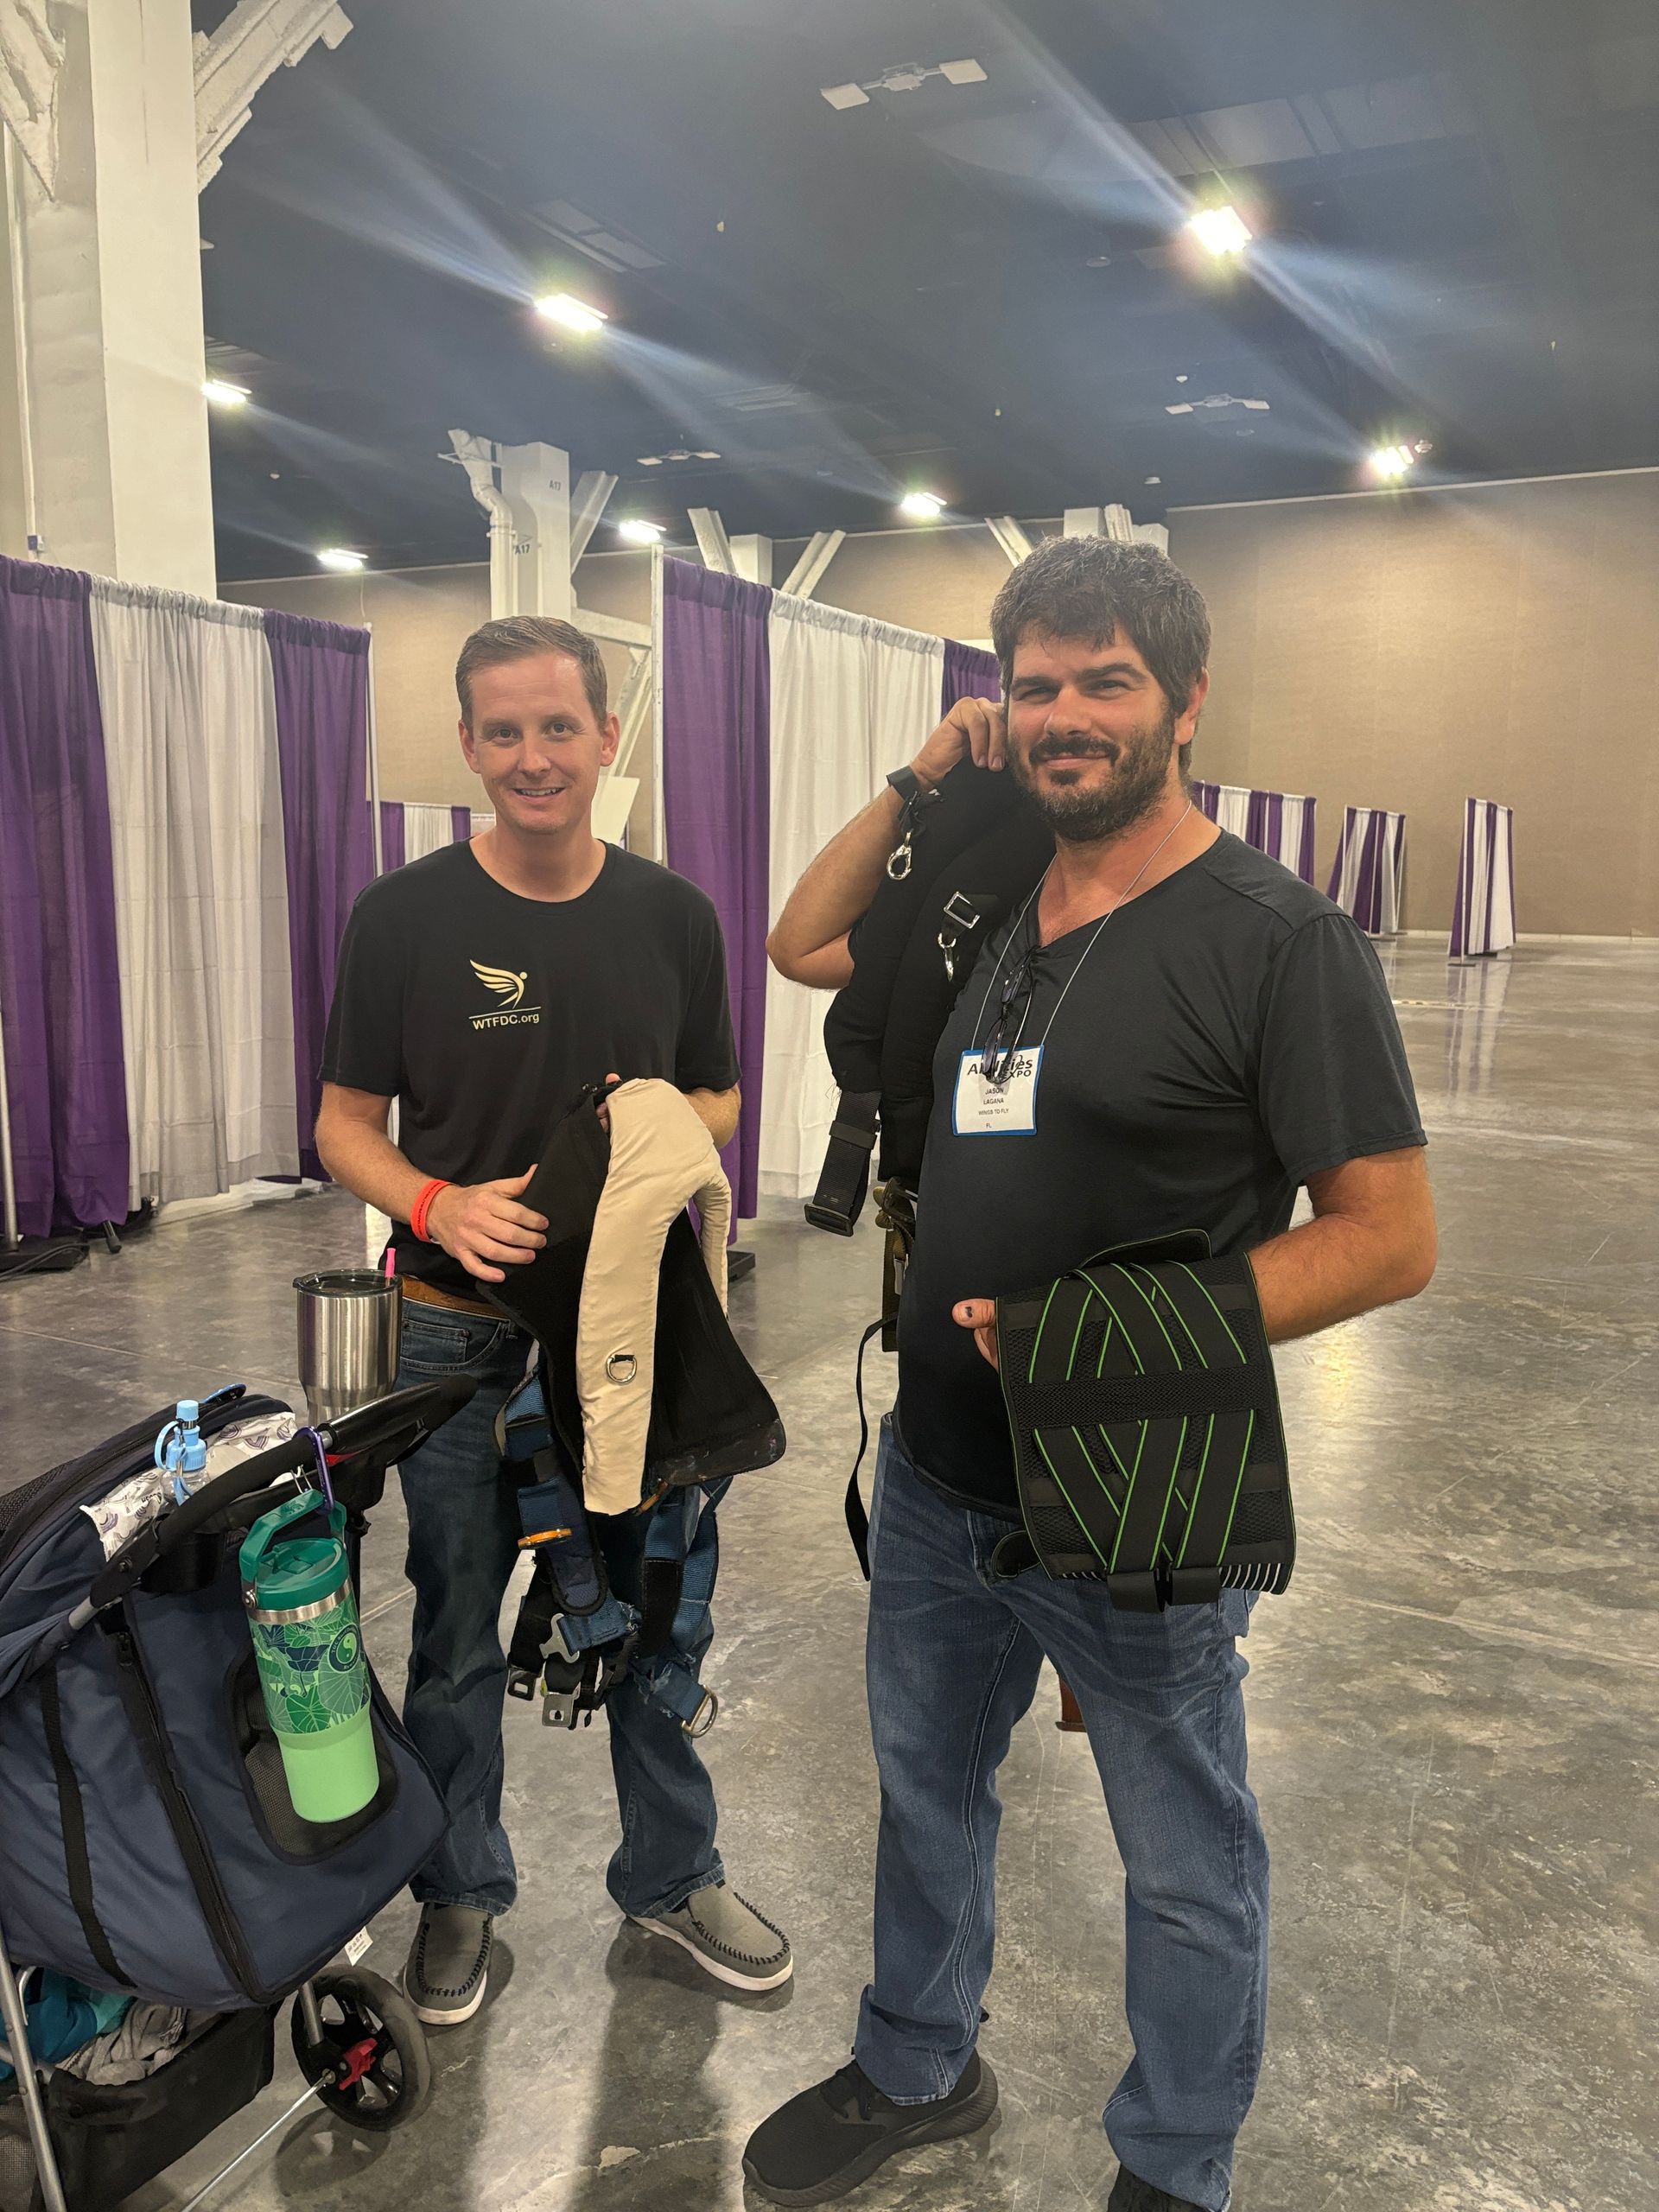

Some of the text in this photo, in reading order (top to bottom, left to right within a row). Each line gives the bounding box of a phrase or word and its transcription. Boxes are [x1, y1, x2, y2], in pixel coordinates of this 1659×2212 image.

[549, 480, 562, 492] A17
[514, 543, 531, 555] A17
[473, 1013, 540, 1030] WTFDC.org
